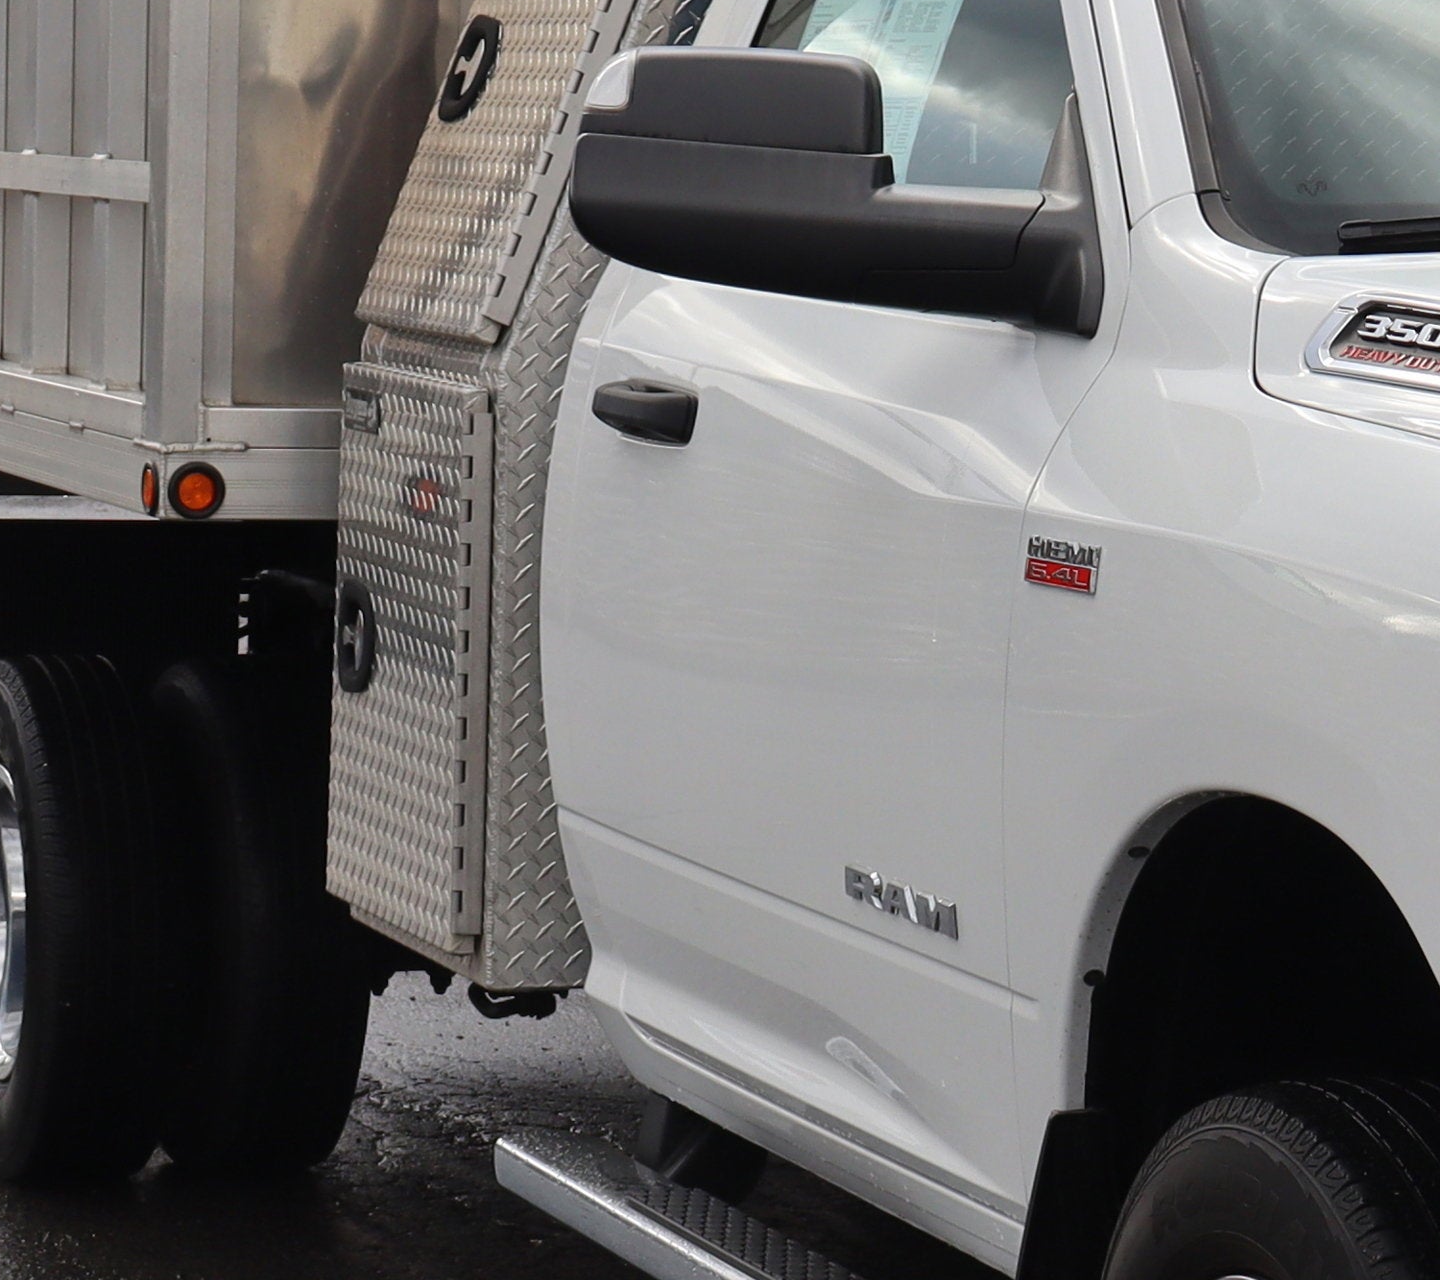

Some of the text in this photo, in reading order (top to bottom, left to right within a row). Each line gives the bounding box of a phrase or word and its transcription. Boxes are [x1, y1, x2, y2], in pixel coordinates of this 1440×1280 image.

[1339, 344, 1406, 368] HEAVY
[1027, 534, 1102, 568] HEMI
[843, 861, 960, 942] RAM
